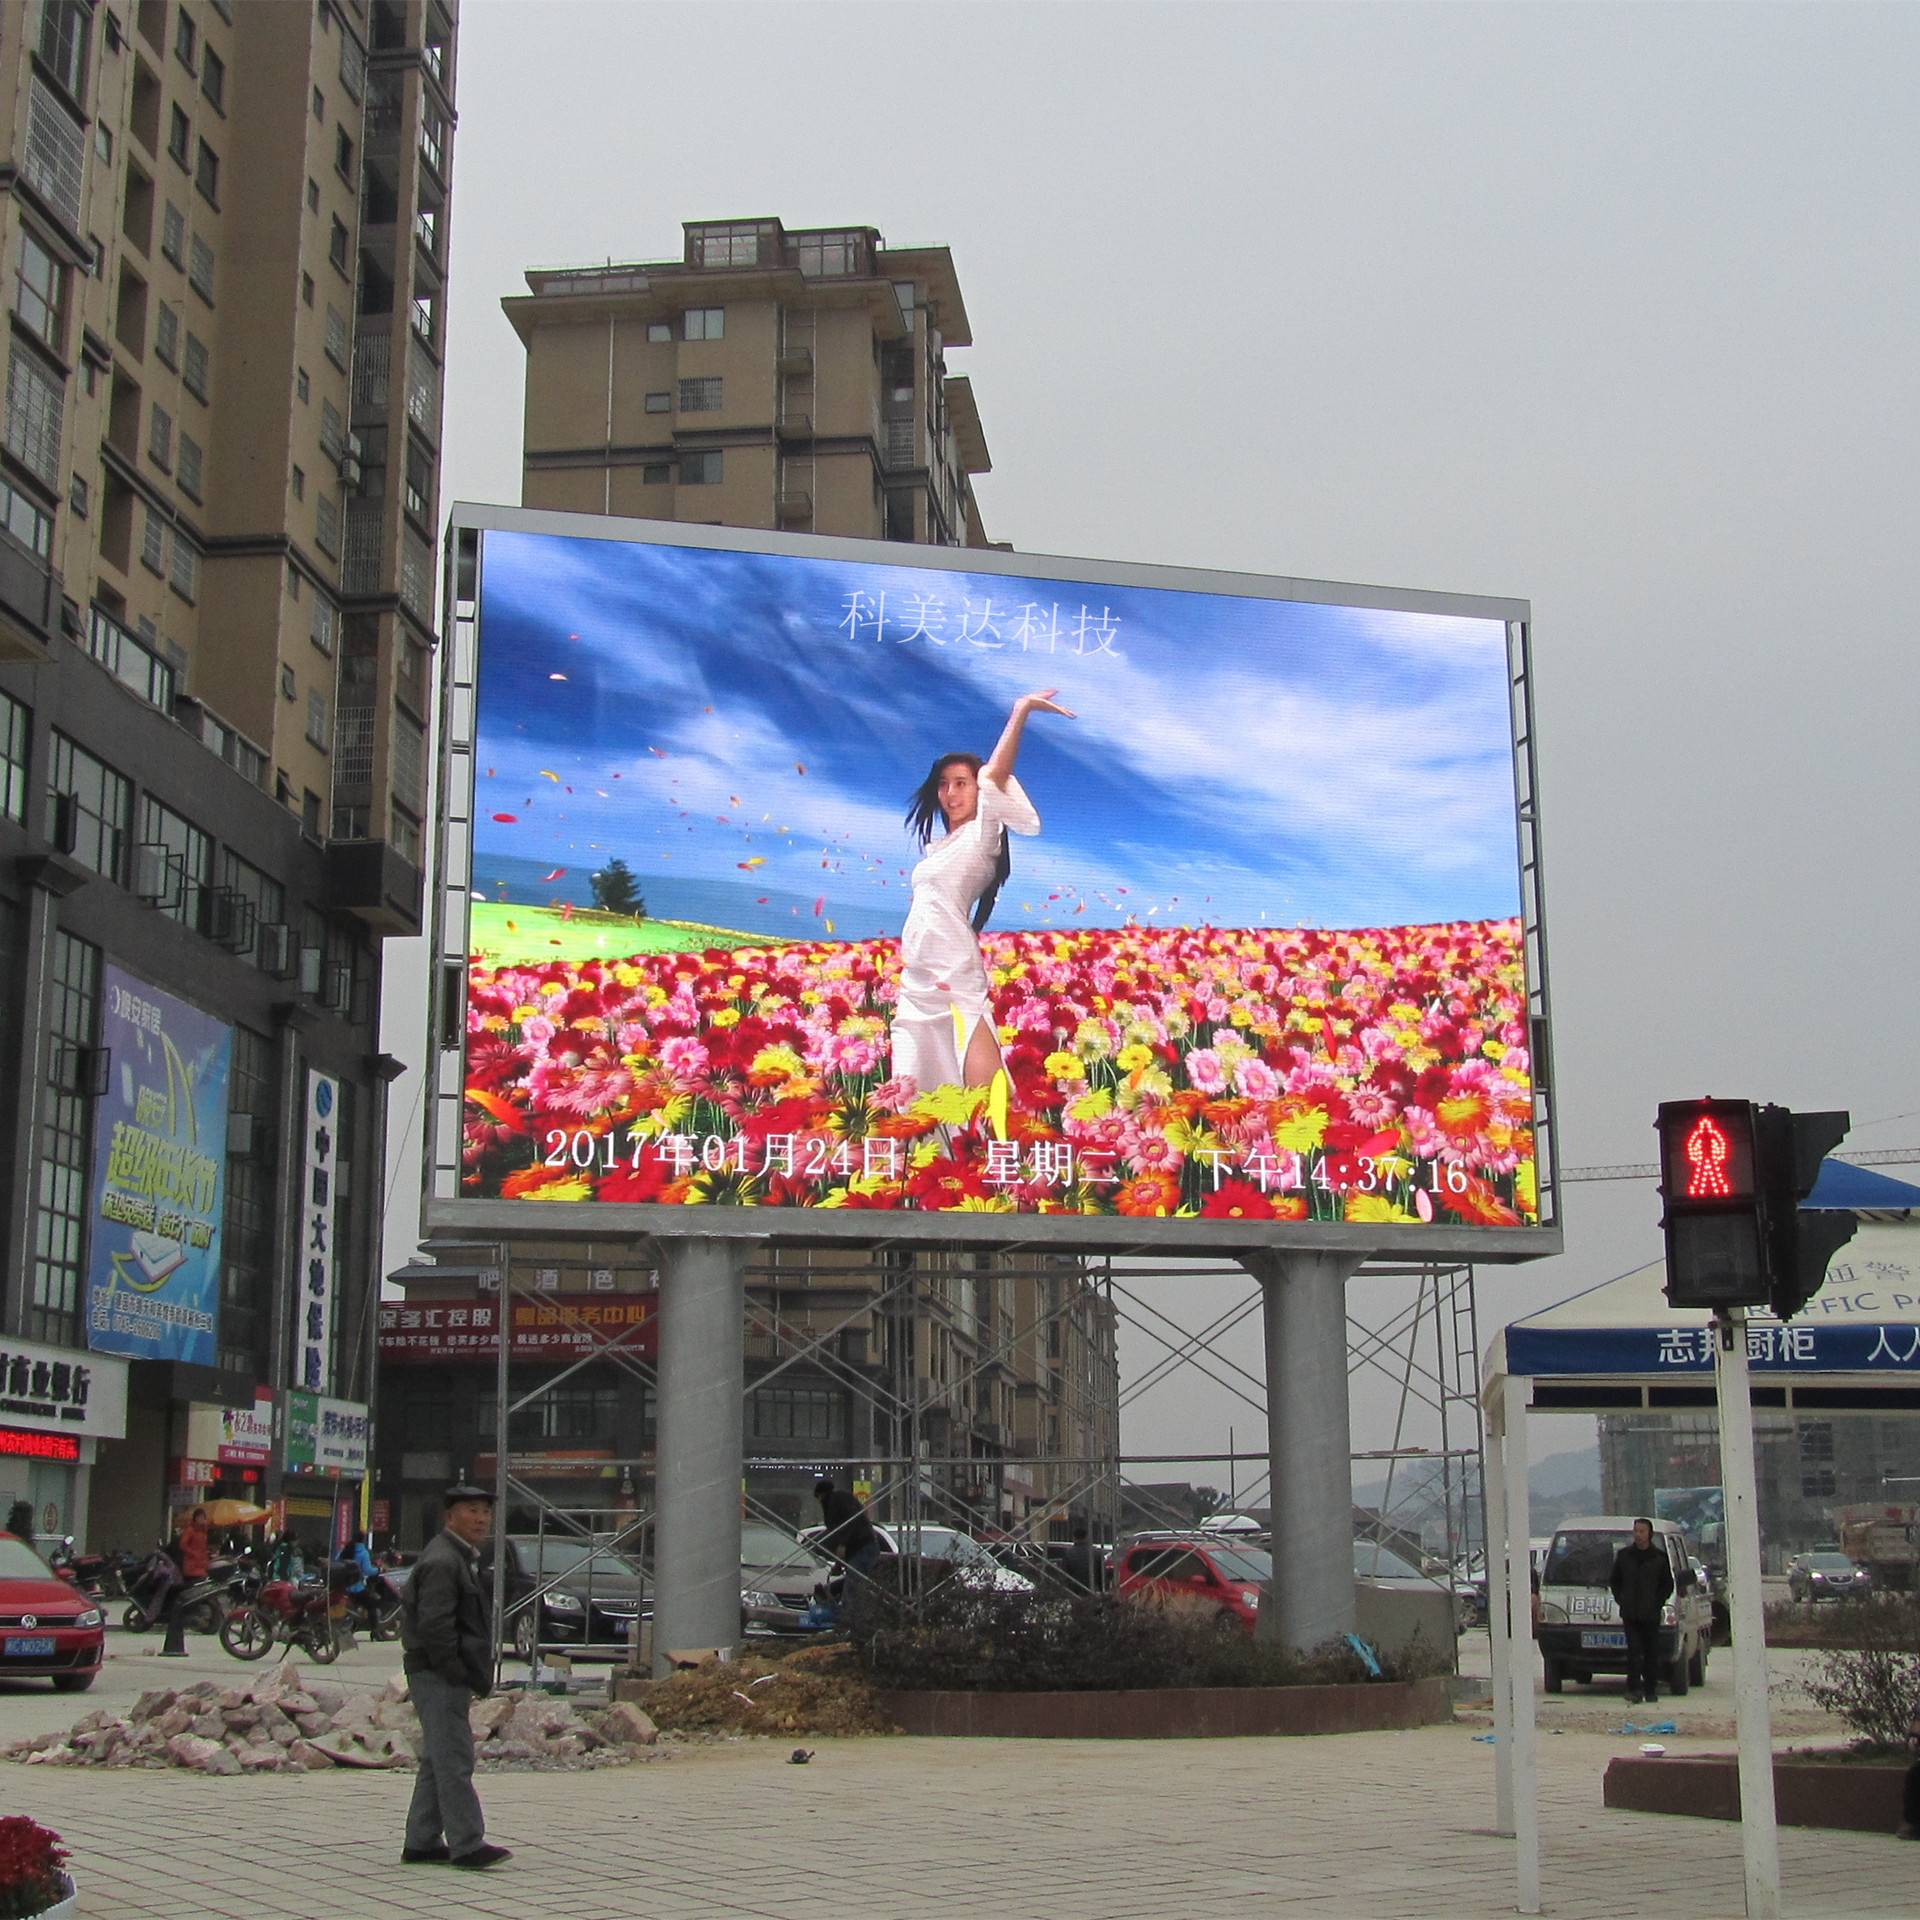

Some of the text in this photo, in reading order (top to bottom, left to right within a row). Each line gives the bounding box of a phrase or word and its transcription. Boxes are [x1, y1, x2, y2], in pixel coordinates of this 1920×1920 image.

[839, 589, 1122, 658] 科美达科技
[545, 1128, 897, 1180] 2017年01月24日
[981, 1138, 1121, 1189] 星期二
[1893, 1294, 1920, 1309] P
